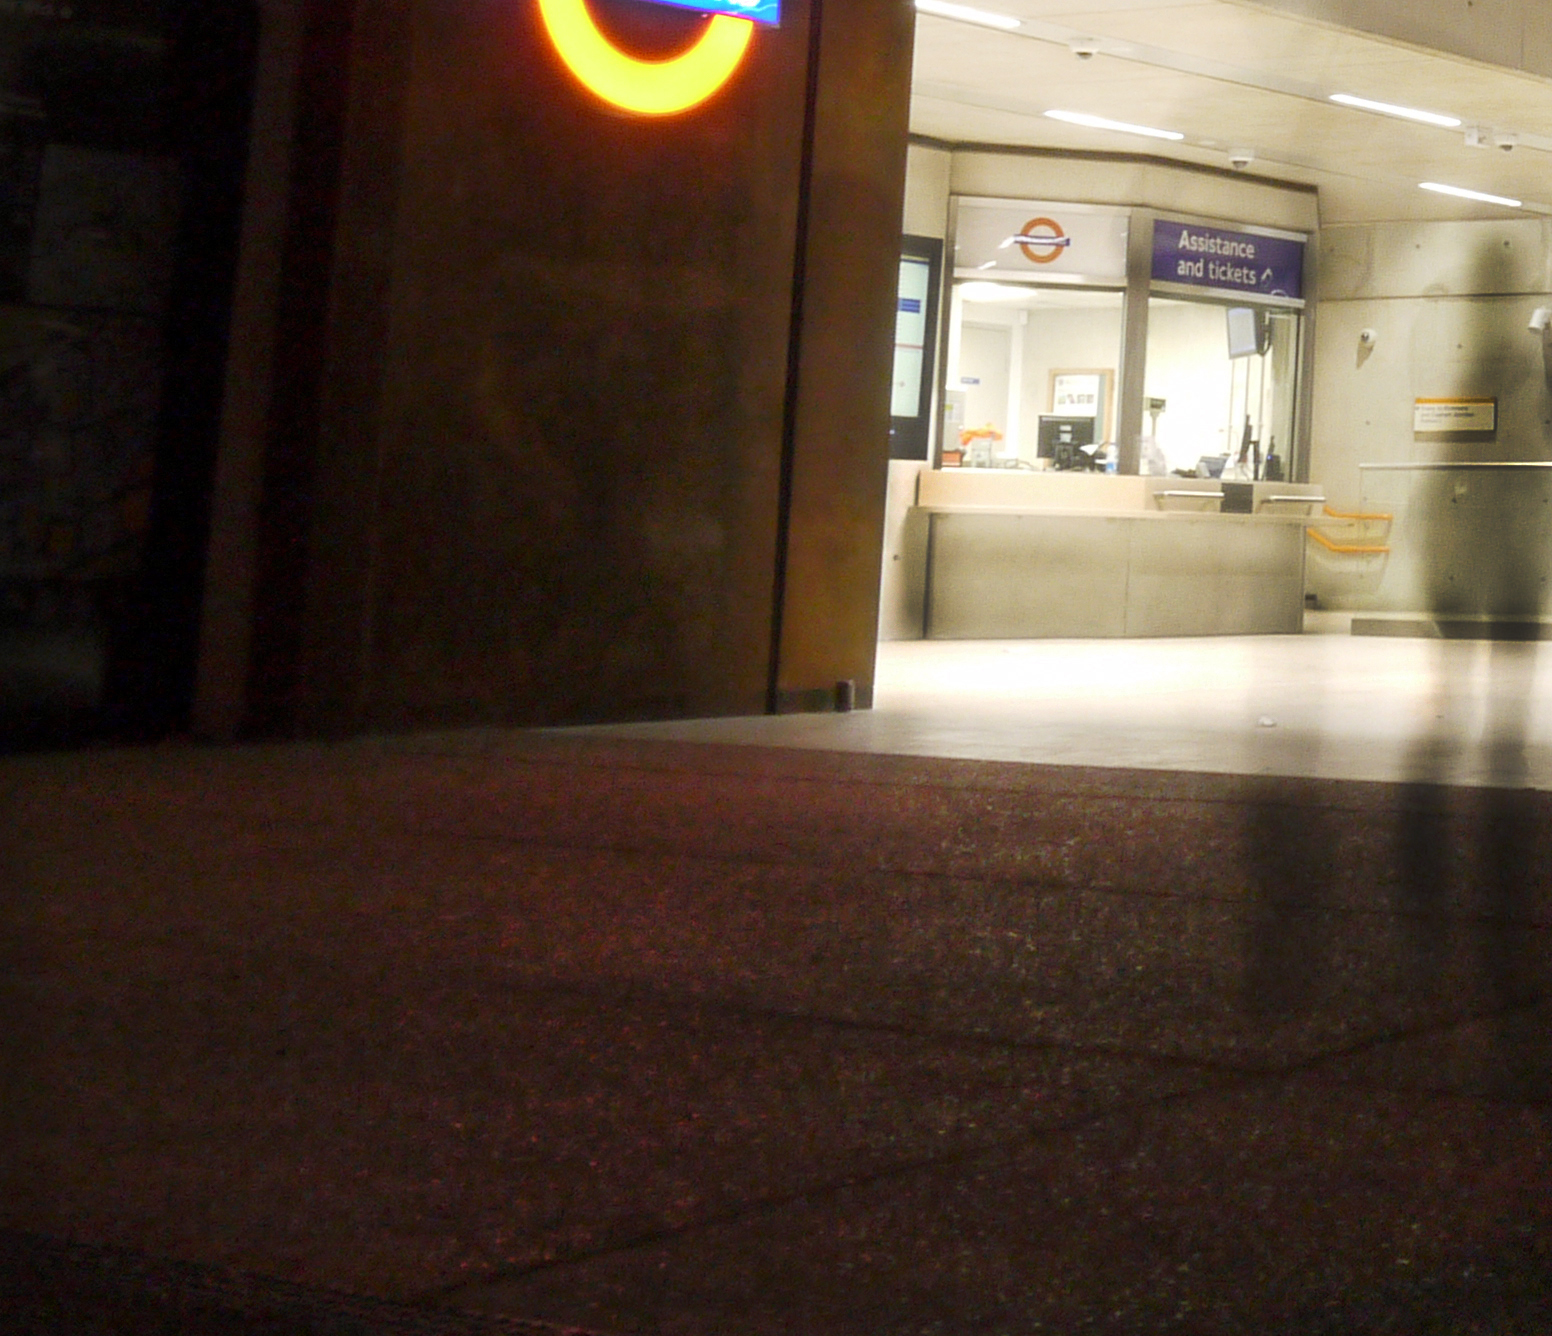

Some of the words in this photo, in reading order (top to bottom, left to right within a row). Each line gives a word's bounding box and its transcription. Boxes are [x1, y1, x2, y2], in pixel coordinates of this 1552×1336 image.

[1178, 229, 1256, 259] Assistance
[1177, 259, 1204, 279] and
[1208, 260, 1257, 285] tickets
